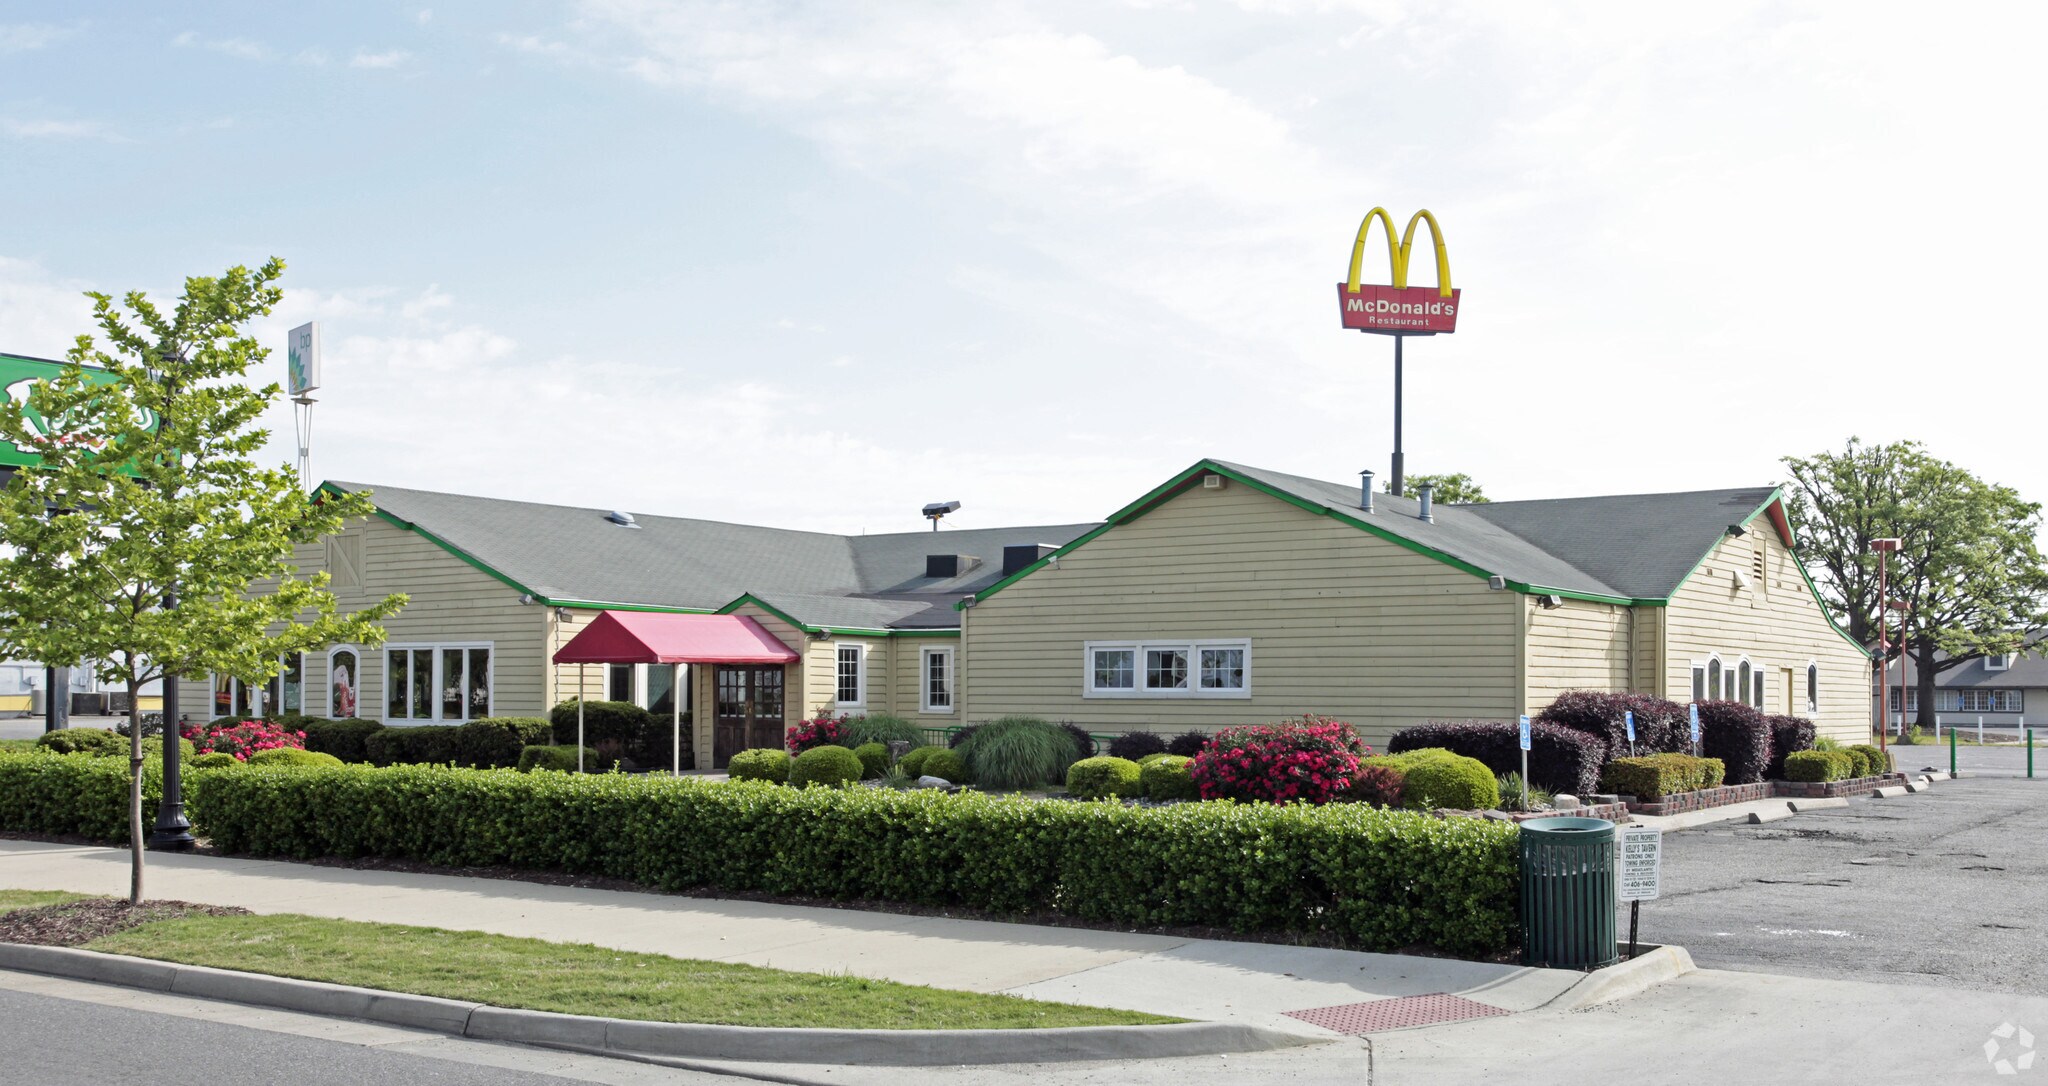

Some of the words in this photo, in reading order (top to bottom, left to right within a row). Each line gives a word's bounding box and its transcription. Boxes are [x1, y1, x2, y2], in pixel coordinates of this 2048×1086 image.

[1347, 299, 1454, 316] McDonald's
[1369, 316, 1430, 326] Restaurant
[300, 332, 311, 352] bp
[1626, 844, 1640, 853] KELLY'S
[1641, 844, 1656, 852] TAVERN
